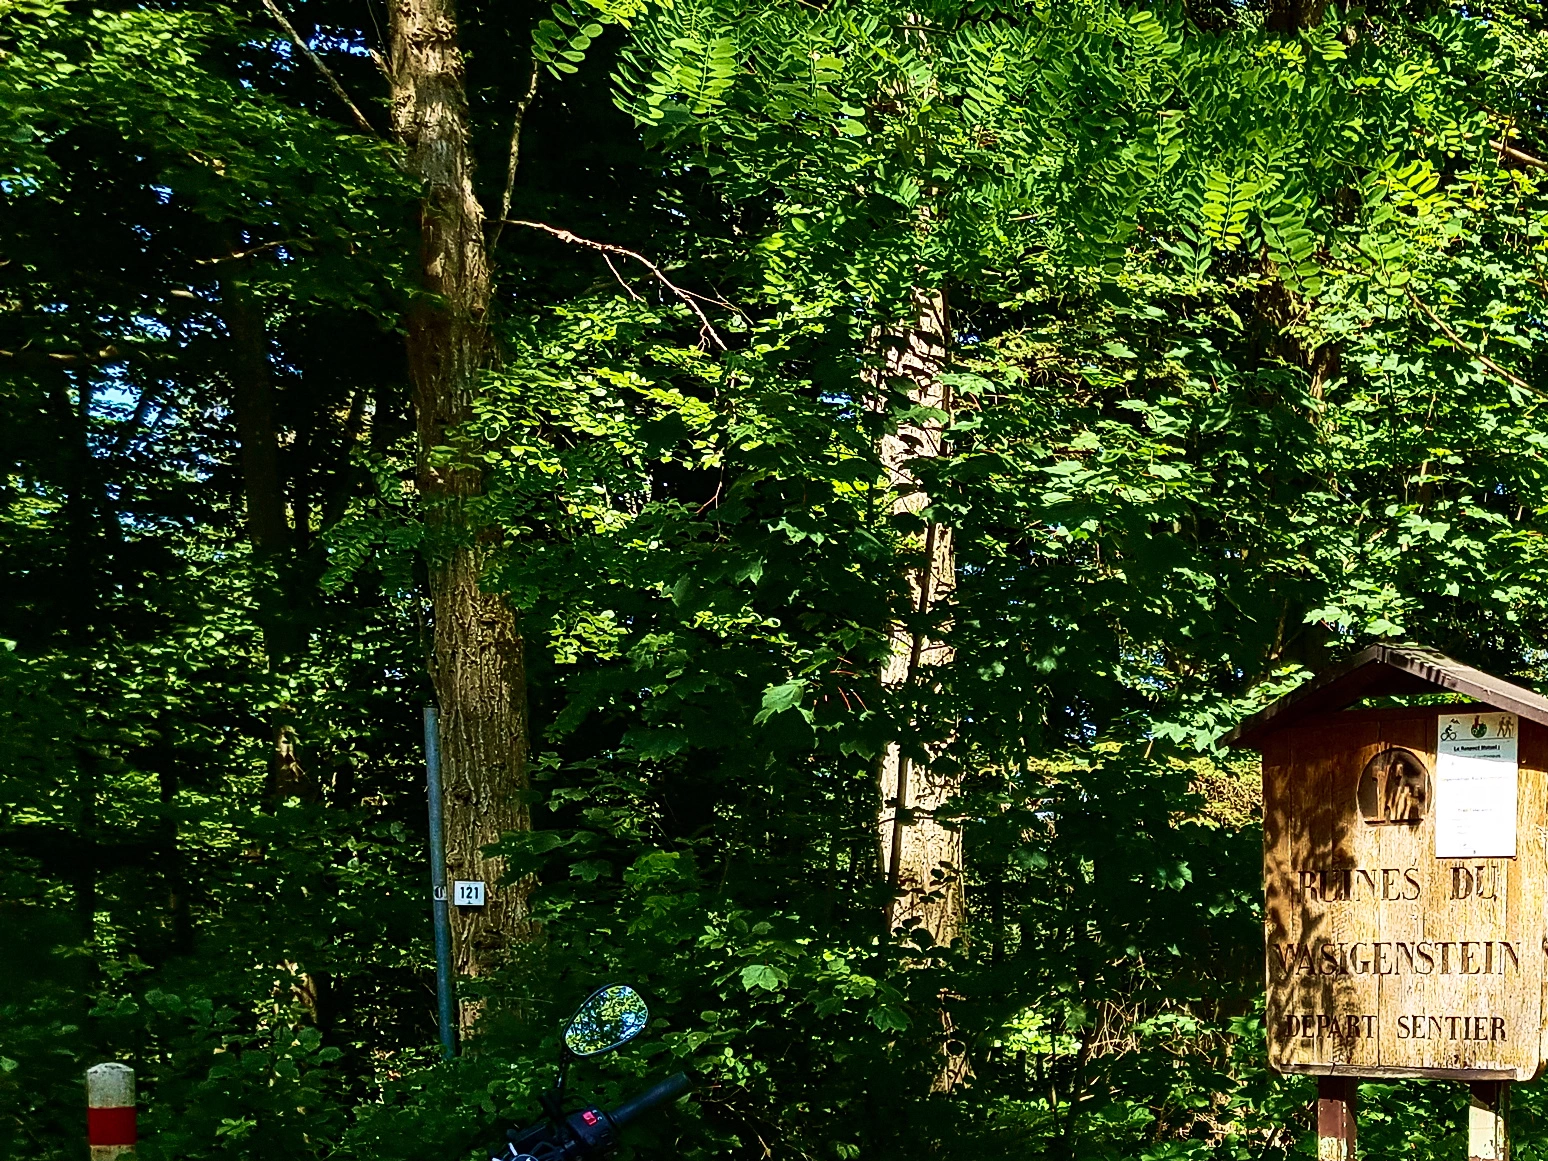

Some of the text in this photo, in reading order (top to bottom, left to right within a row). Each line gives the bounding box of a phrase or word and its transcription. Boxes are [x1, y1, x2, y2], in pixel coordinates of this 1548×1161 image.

[460, 886, 479, 900] 121
[1299, 866, 1497, 902] RUINES DU
[1397, 1015, 1507, 1042] SENTIER
